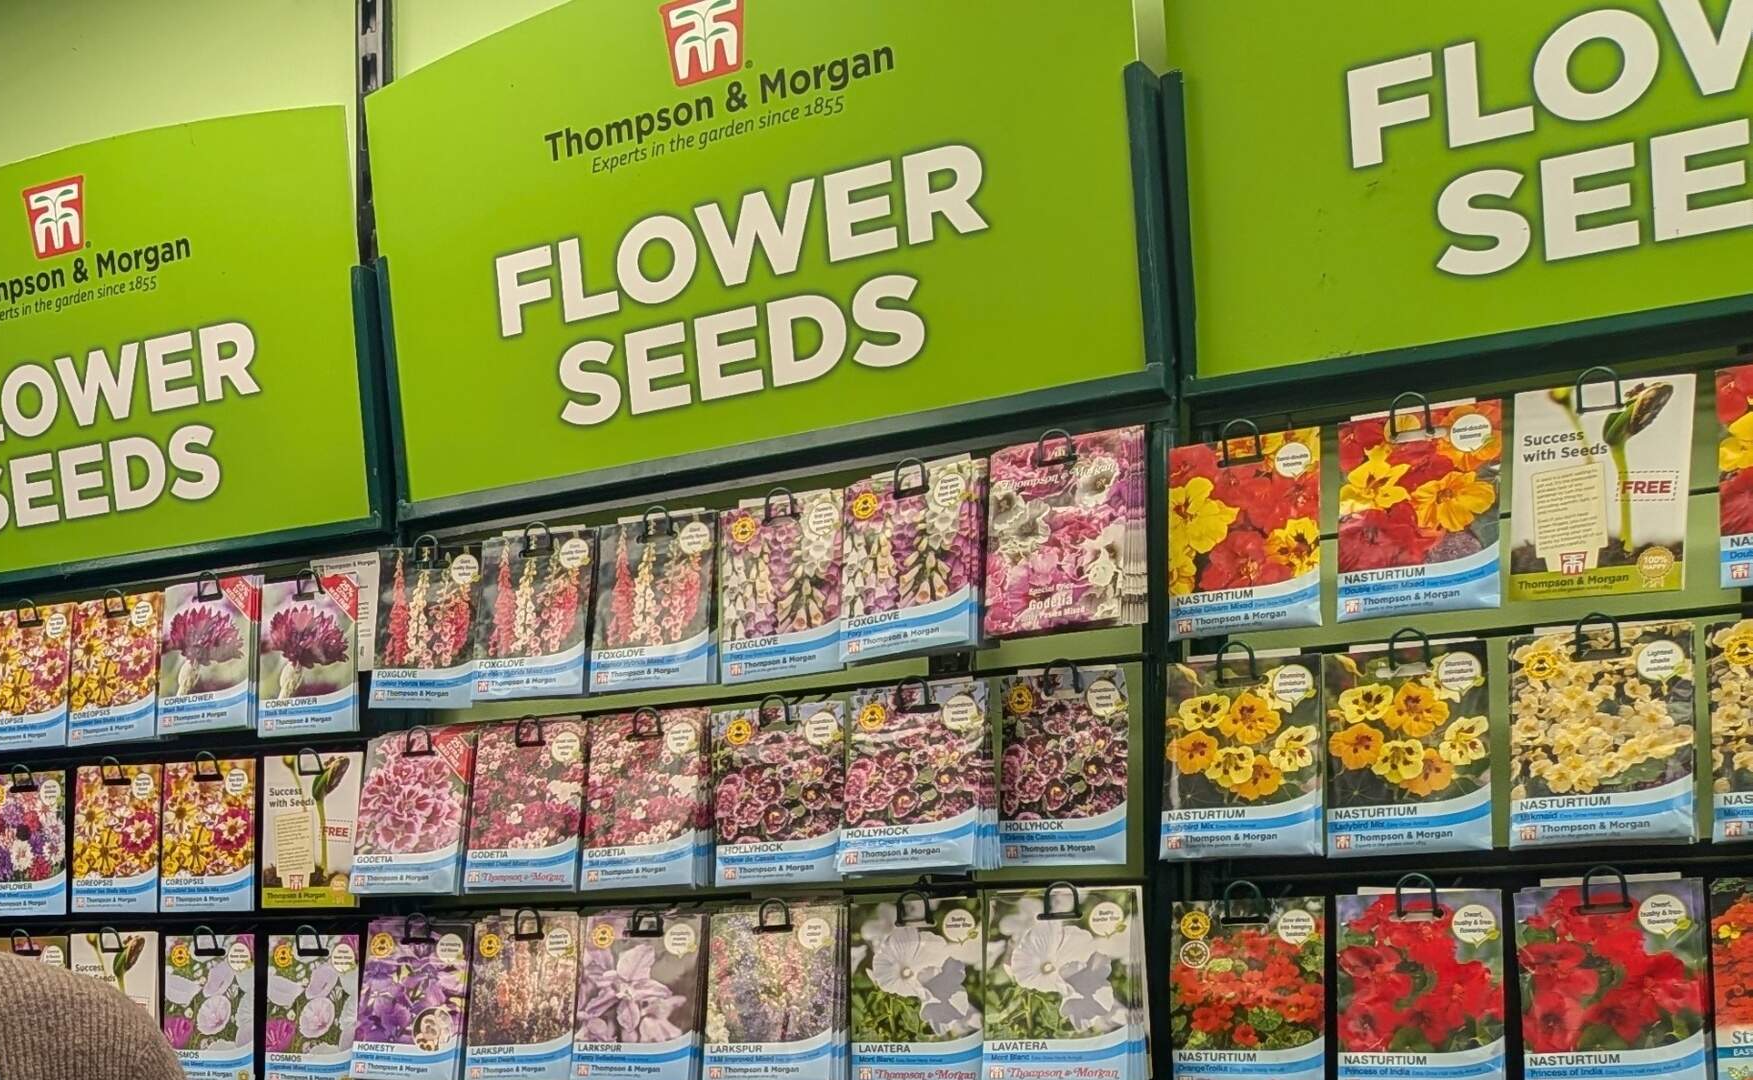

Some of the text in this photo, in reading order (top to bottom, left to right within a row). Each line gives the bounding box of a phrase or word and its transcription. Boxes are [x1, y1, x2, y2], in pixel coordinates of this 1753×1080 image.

[1347, 0, 1753, 169] FLO
[545, 44, 895, 164] Thompson & Morgan
[591, 94, 845, 175] Experts in the garden since 1855
[1436, 117, 1753, 276] SEE
[496, 145, 989, 338] FLOWER
[72, 257, 89, 283] &
[97, 236, 191, 280] Morgan
[21, 303, 32, 316] in
[34, 298, 53, 313] the
[55, 288, 95, 313] garden
[98, 282, 126, 299] since
[128, 274, 157, 293] 1855
[560, 274, 926, 426] SEEDS
[1523, 432, 1584, 446] Success
[1523, 445, 1608, 462] with Seeds
[1622, 479, 1672, 495] FREE
[1344, 567, 1425, 584] NASTURTIUM
[1518, 573, 1629, 590] Thompson & Morgan
[1177, 589, 1253, 606] NASTURTIUM
[730, 637, 778, 651] FOXGLOVE
[164, 693, 214, 705] CORNFLOWER
[1520, 796, 1611, 810] NASTURTIUM
[1168, 810, 1246, 821] NASTURTIUM
[1334, 806, 1418, 819] NASTURTIUM
[1005, 821, 1063, 831] HOLLYHOCK
[358, 1044, 395, 1052] HONESTY
[710, 1045, 762, 1053] LARKSPUR
[992, 1042, 1048, 1051] LAVATERA
[1178, 1052, 1257, 1062] NASTURTIUM
[1344, 1055, 1427, 1065] NASTURTIUM
[1529, 1054, 1621, 1066] NASTURTIUM
[1530, 1068, 1602, 1077] Princess of India
